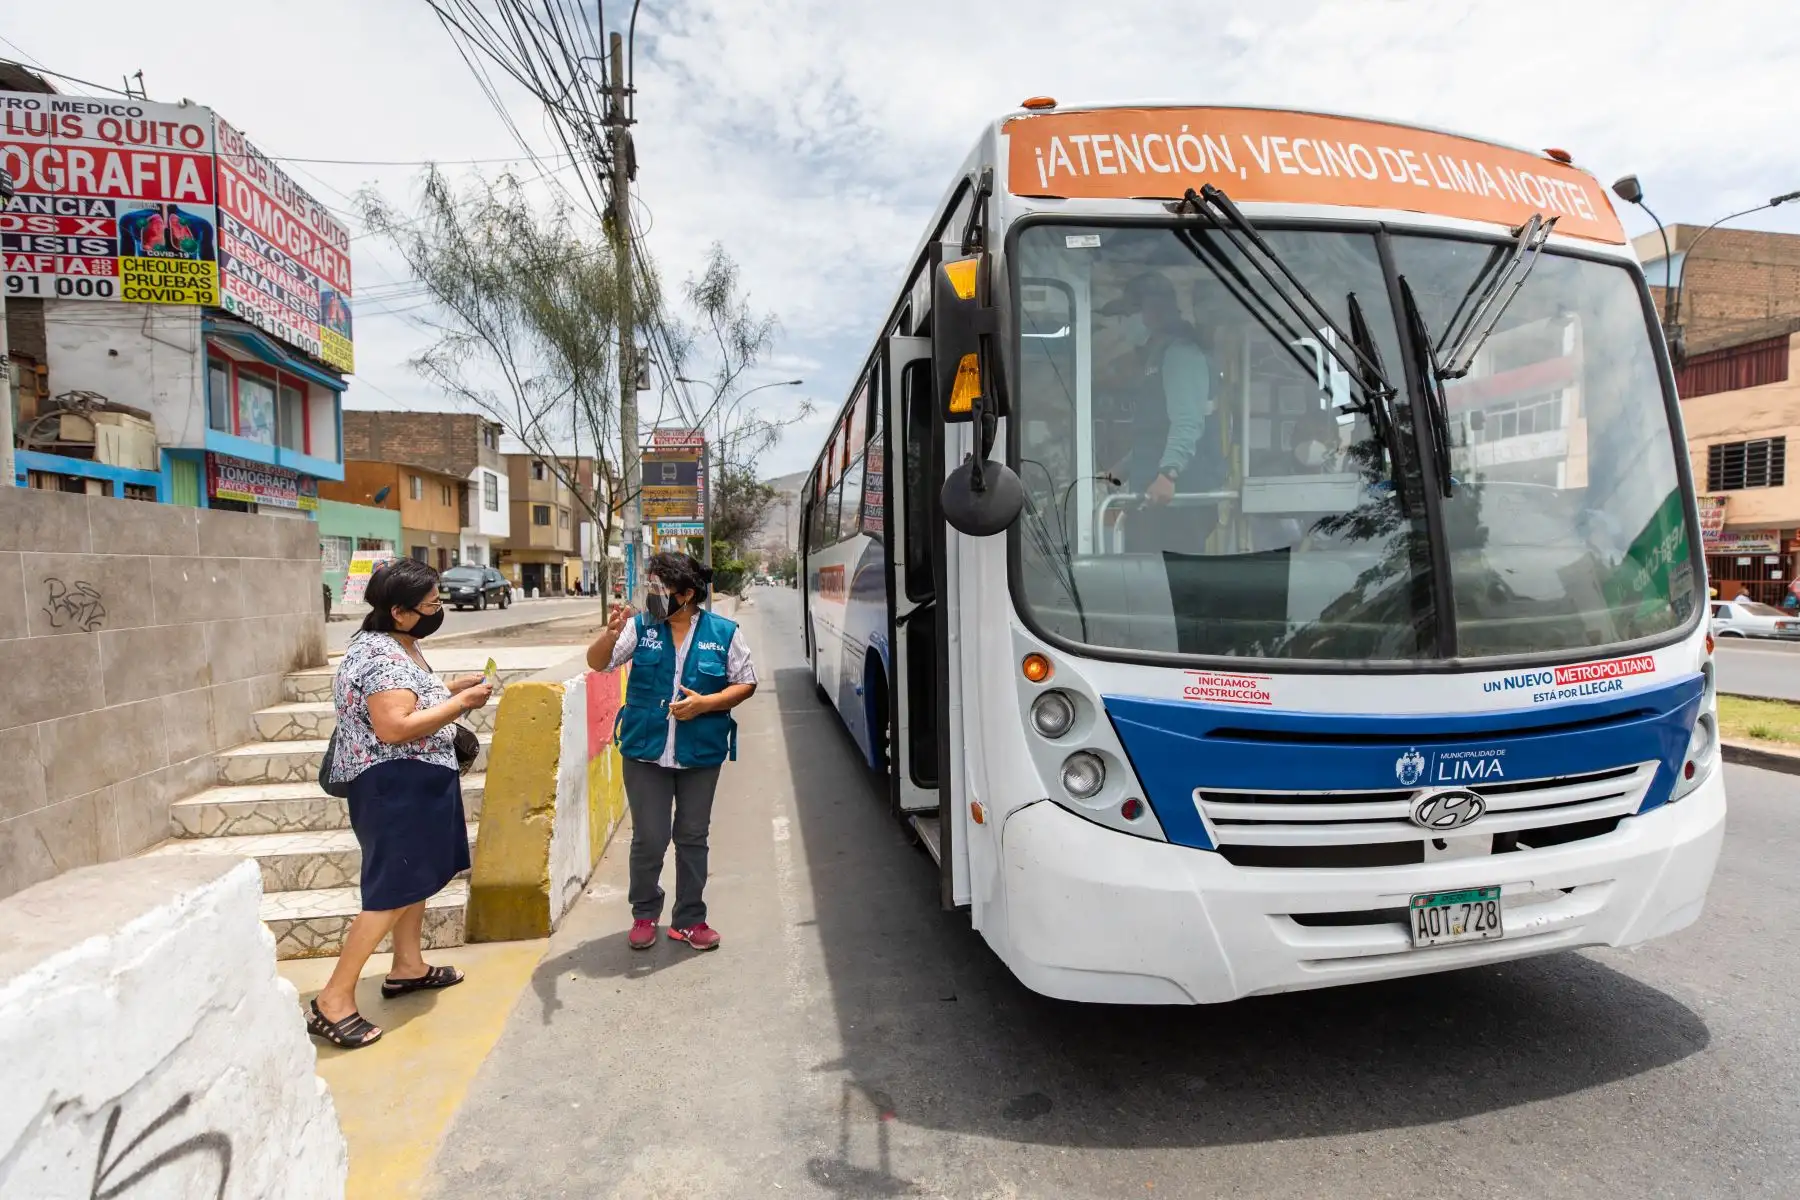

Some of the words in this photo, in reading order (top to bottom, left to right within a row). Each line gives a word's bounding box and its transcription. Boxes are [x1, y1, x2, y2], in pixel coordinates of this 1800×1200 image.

[52, 100, 143, 118] MEDICO
[6, 110, 84, 140] LUIS
[97, 117, 205, 149] QUITO
[245, 139, 289, 183] CENTRO
[1035, 124, 1247, 189] ¡ATENCIÓN,
[1242, 134, 1378, 181] VECINO
[1376, 146, 1431, 188] DE
[1423, 152, 1506, 200] LIMA
[1497, 165, 1599, 222] NORTE!
[0, 195, 112, 217] ANCIA
[273, 174, 306, 219] LUIS
[310, 207, 349, 251] QUITO
[74, 218, 109, 236] X
[220, 163, 350, 289] TOMOGRAFIA
[223, 213, 299, 277] RAYOS
[303, 271, 318, 290] X
[123, 258, 212, 276] CHEQUEOS
[224, 233, 319, 308] RESONANCIA
[55, 277, 114, 298] 000
[123, 272, 212, 290] PRUEBAS
[226, 256, 319, 322] ANALISIS
[123, 287, 213, 304] COVID-19
[225, 274, 311, 335] ECOGRAFIA
[218, 465, 297, 491] TOMOGRAFIA
[218, 479, 248, 493] RAYOS
[1198, 676, 1257, 689] INICIAMOS
[1483, 681, 1501, 693] UN
[1503, 671, 1553, 690] NUEVO
[1555, 657, 1654, 685] METROPOLITANO
[1183, 686, 1270, 700] CONSTRUCCIÓN
[1533, 689, 1557, 702] ESTÁ
[1558, 688, 1578, 699] POR
[1579, 679, 1623, 696] LLEGAR
[1440, 750, 1496, 760] MUNICIPALIDAD
[1438, 758, 1505, 781] LIMA
